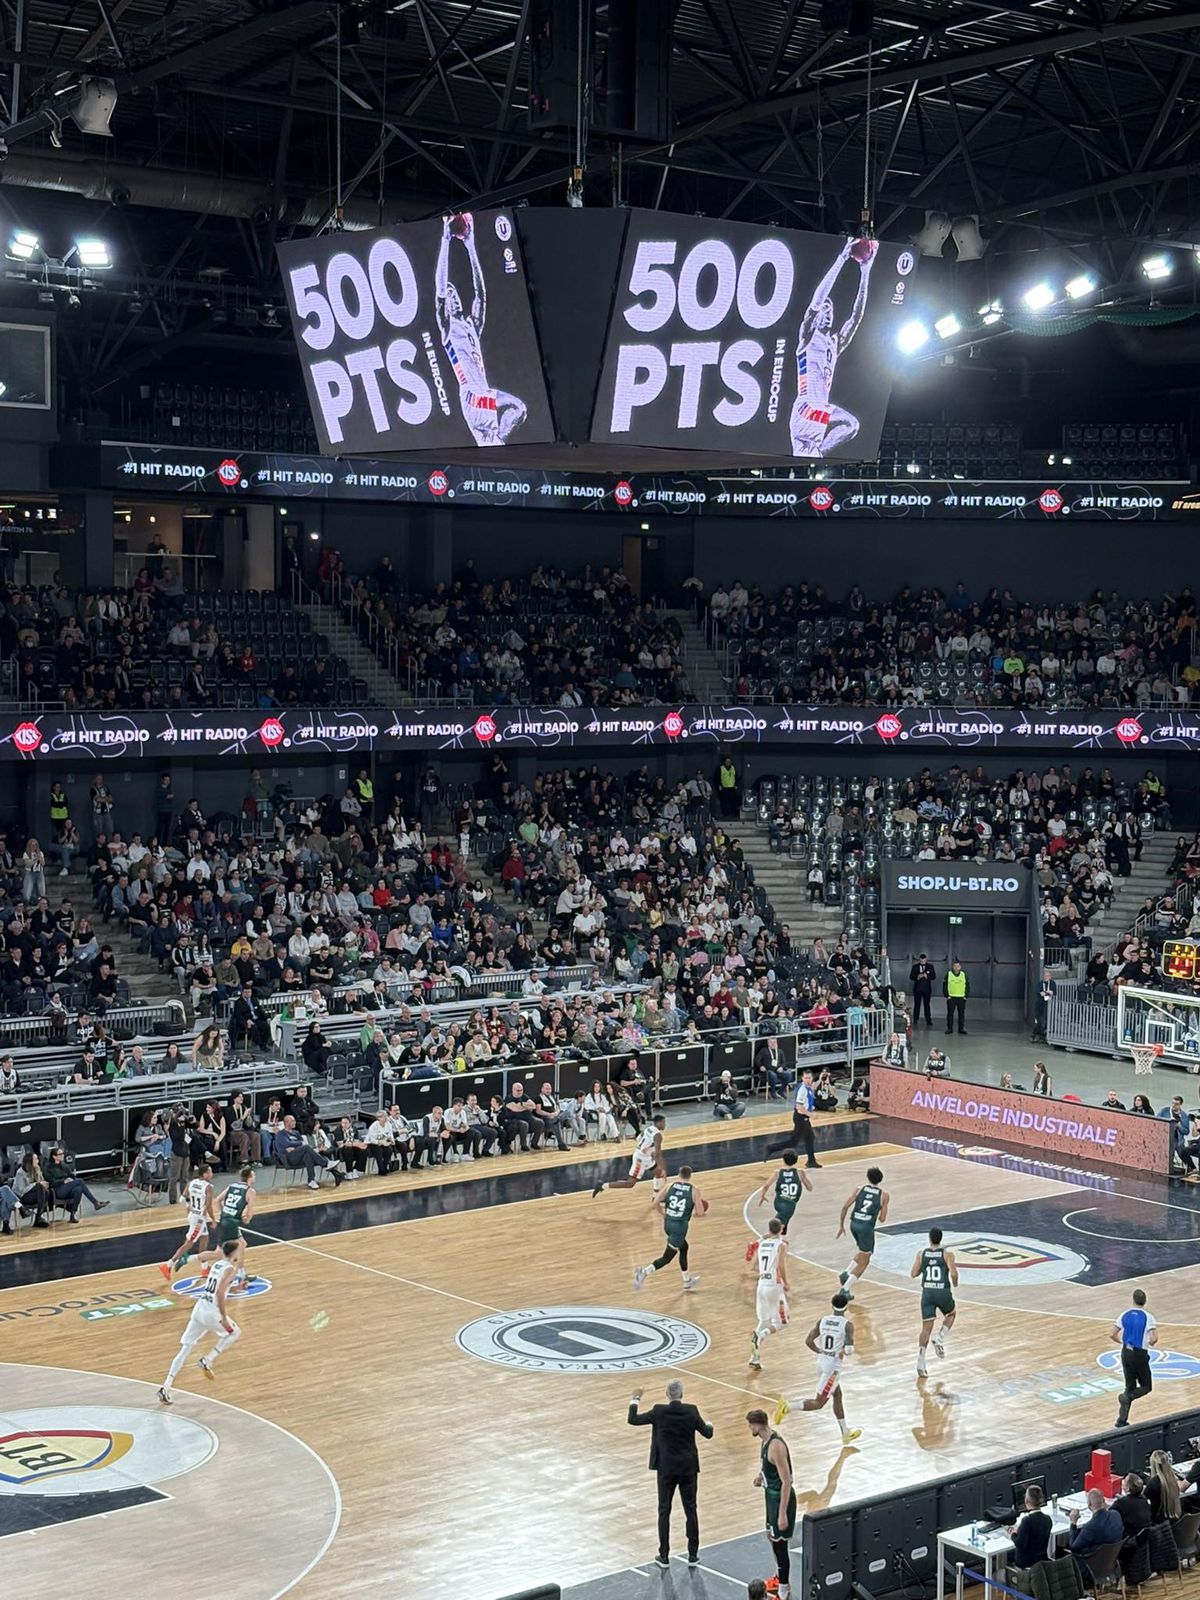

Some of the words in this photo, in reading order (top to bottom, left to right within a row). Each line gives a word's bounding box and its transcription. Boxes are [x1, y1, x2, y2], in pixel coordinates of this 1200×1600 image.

[623, 239, 794, 332] 500
[290, 238, 418, 350] 500
[422, 332, 433, 349] IN
[776, 339, 786, 356] IN
[426, 350, 451, 416] EUROCUP
[610, 339, 764, 433] PTS
[768, 357, 785, 423] EUROCUP
[310, 339, 432, 444] PTS
[123, 463, 137, 474] #1
[141, 463, 162, 476] HIT
[164, 464, 206, 478] RADIO
[258, 470, 271, 481] #1
[273, 471, 293, 482] HIT
[295, 471, 334, 484] RADIO
[345, 474, 358, 485] #1
[360, 475, 379, 486] HIT
[381, 476, 417, 488] RADIO
[463, 480, 475, 491] #1
[476, 481, 495, 493] HIT
[497, 483, 531, 494] RADIO
[540, 484, 552, 495] #1
[553, 485, 571, 496] HIT
[572, 486, 605, 498] RADIO
[645, 490, 656, 501] #1
[657, 491, 674, 502] HIT
[675, 491, 706, 503] RADIO
[717, 493, 730, 504] #1
[733, 493, 754, 504] HIT
[756, 493, 797, 504] RADIO
[850, 495, 863, 505] #1
[866, 495, 888, 505] HIT
[890, 495, 931, 506] RADIO
[943, 496, 958, 506] #1
[960, 496, 982, 506] HIT
[984, 496, 1026, 506] RADIO
[1080, 497, 1094, 507] #1
[1097, 497, 1119, 507] HIT
[1121, 497, 1163, 508] RADIO
[300, 726, 314, 739] #1
[316, 726, 337, 738] HIT
[338, 725, 378, 738] RADIO
[389, 724, 402, 736] #1
[404, 724, 424, 736] HIT
[425, 723, 464, 736] RADIO
[510, 723, 522, 734] #1
[525, 722, 542, 734] HIT
[544, 722, 579, 733] RADIO
[588, 722, 600, 733] #1
[602, 721, 620, 733] HIT
[621, 720, 654, 732] RADIO
[695, 719, 707, 730] #1
[708, 719, 725, 730] HIT
[726, 719, 767, 731] RADIO
[779, 719, 794, 731] #1
[796, 720, 819, 731] HIT
[821, 720, 864, 732] RADIO
[919, 722, 934, 734] #1
[936, 722, 960, 734] HIT
[961, 723, 1004, 735] RADIO
[1016, 724, 1031, 735] #1
[1034, 724, 1057, 735] HIT
[1059, 724, 1103, 736] RADIO
[1159, 726, 1174, 737] #1
[1176, 727, 1198, 738] HIT
[60, 731, 75, 743] #1
[79, 730, 102, 743] HIT
[104, 729, 150, 743] RADIO
[163, 729, 178, 741] #1
[180, 728, 203, 741] HIT
[204, 727, 248, 741] RADIO
[897, 876, 1019, 892] SHOP.U-BT.RO
[911, 1090, 1000, 1123] ANVELOPE
[1002, 1108, 1118, 1147] INDUSTRIALE
[780, 1183, 798, 1196] 30
[225, 1193, 242, 1207] 27
[669, 1195, 687, 1211] 34
[860, 1199, 873, 1213] 7
[959, 1244, 1030, 1261] BT
[761, 1256, 769, 1271] 7
[925, 1266, 941, 1281] 10
[207, 1277, 217, 1294] 10
[87, 1298, 174, 1321] BKT
[518, 1320, 656, 1357] U
[825, 1335, 834, 1350] 0
[558, 1332, 698, 1370] UNIVERSITATEA
[488, 1352, 545, 1367] CLUJ
[1047, 1377, 1122, 1403] BKT
